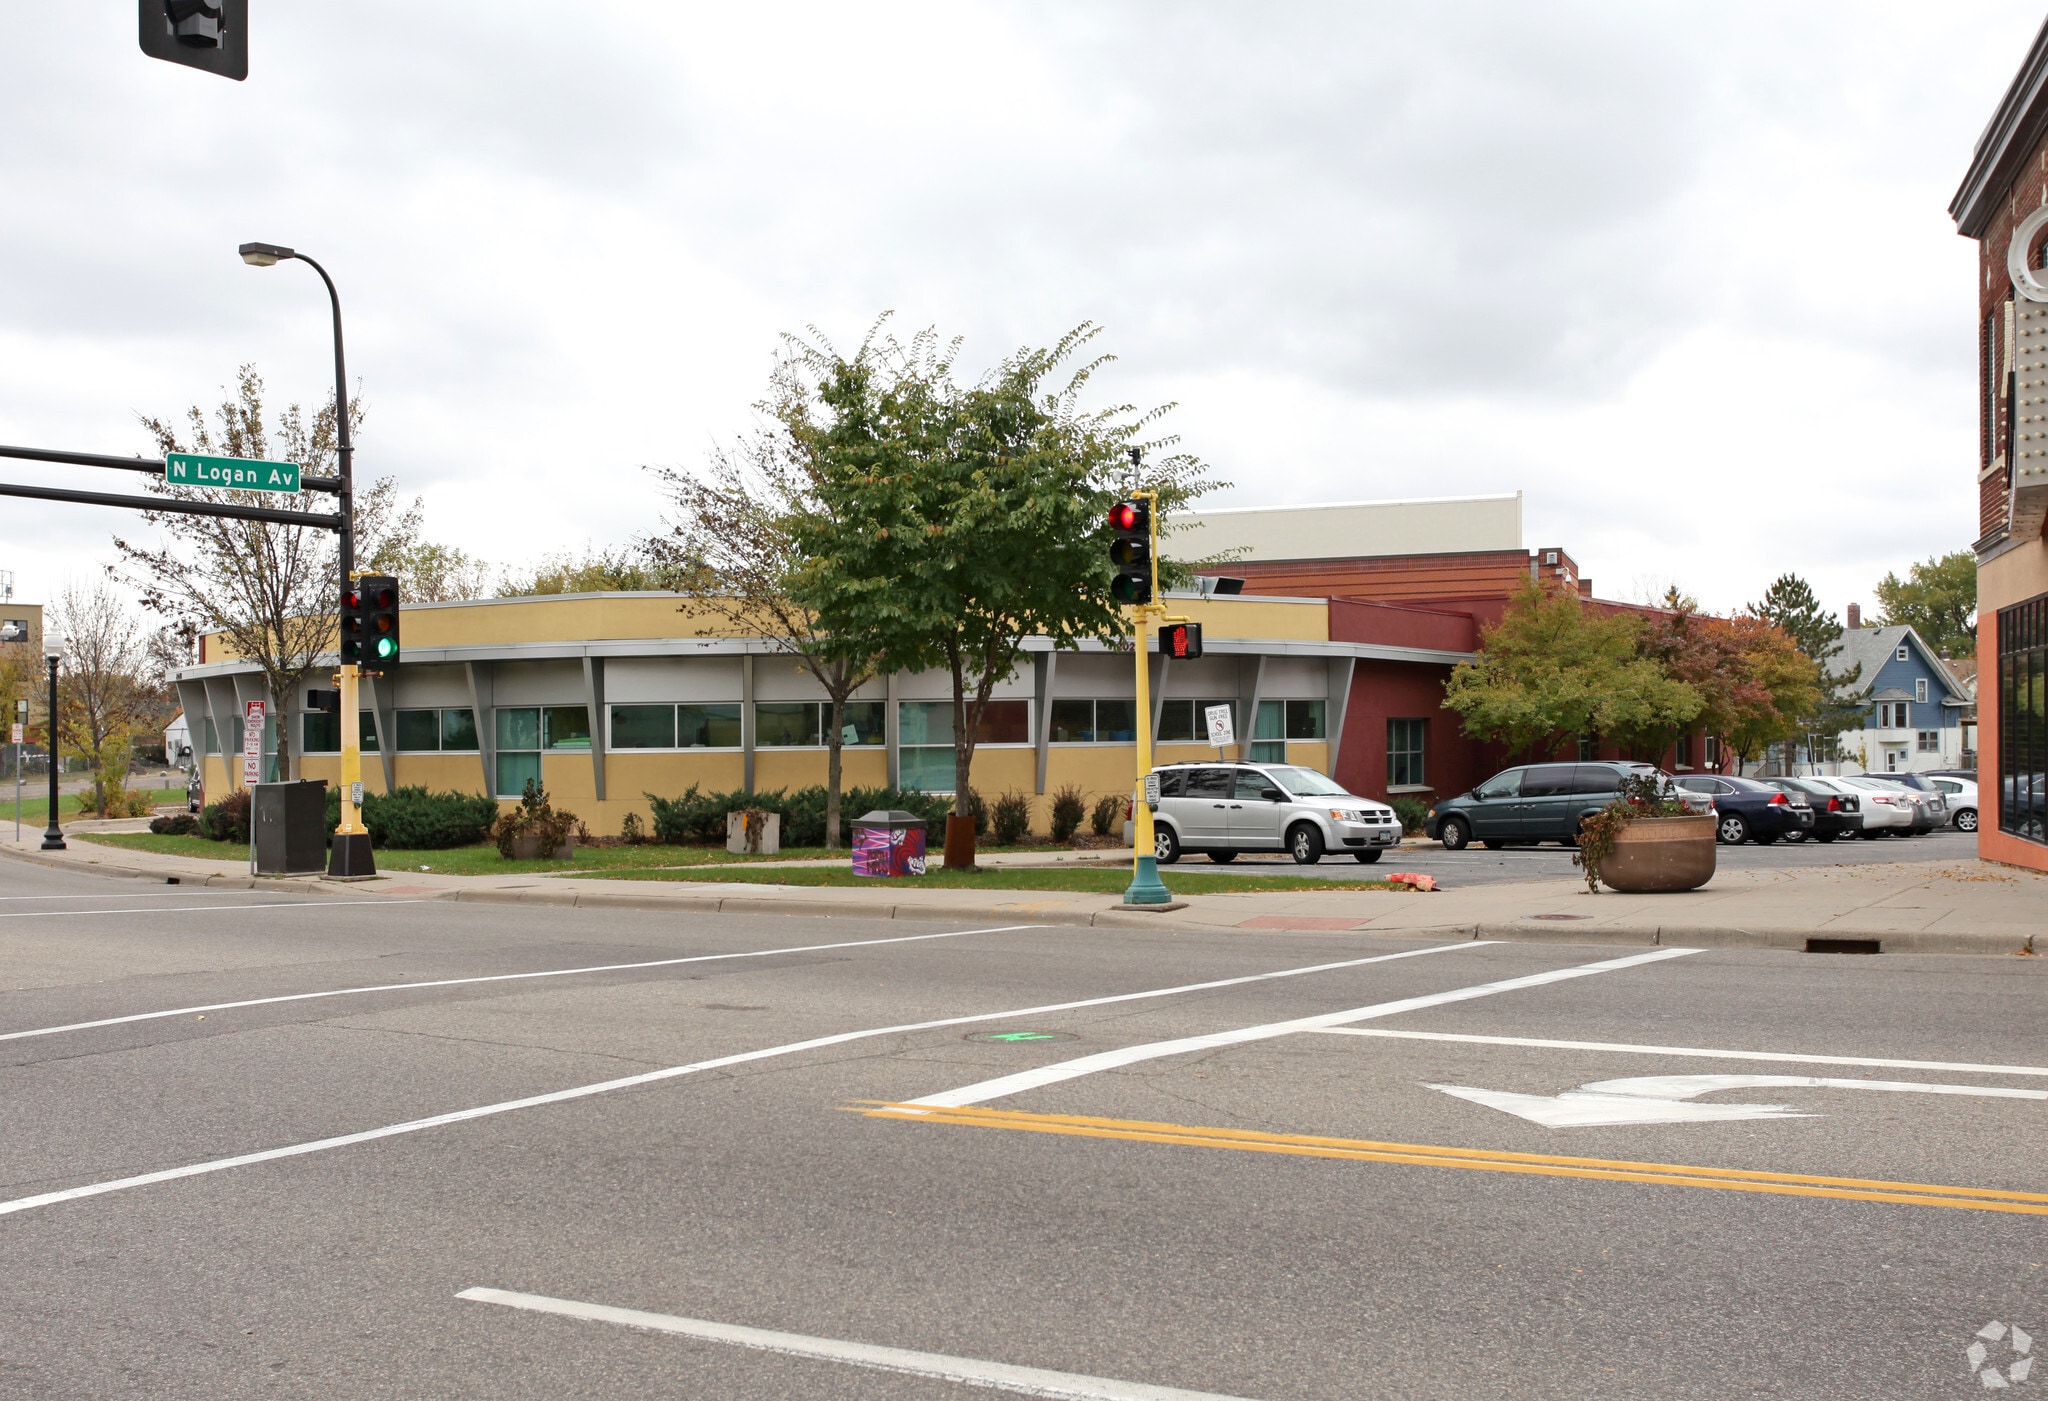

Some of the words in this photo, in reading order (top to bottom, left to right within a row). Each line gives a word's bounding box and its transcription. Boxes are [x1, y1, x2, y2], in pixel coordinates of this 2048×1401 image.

[173, 460, 186, 477] N
[197, 463, 257, 486] Logan
[268, 469, 293, 486] Av
[247, 762, 256, 770] NO
